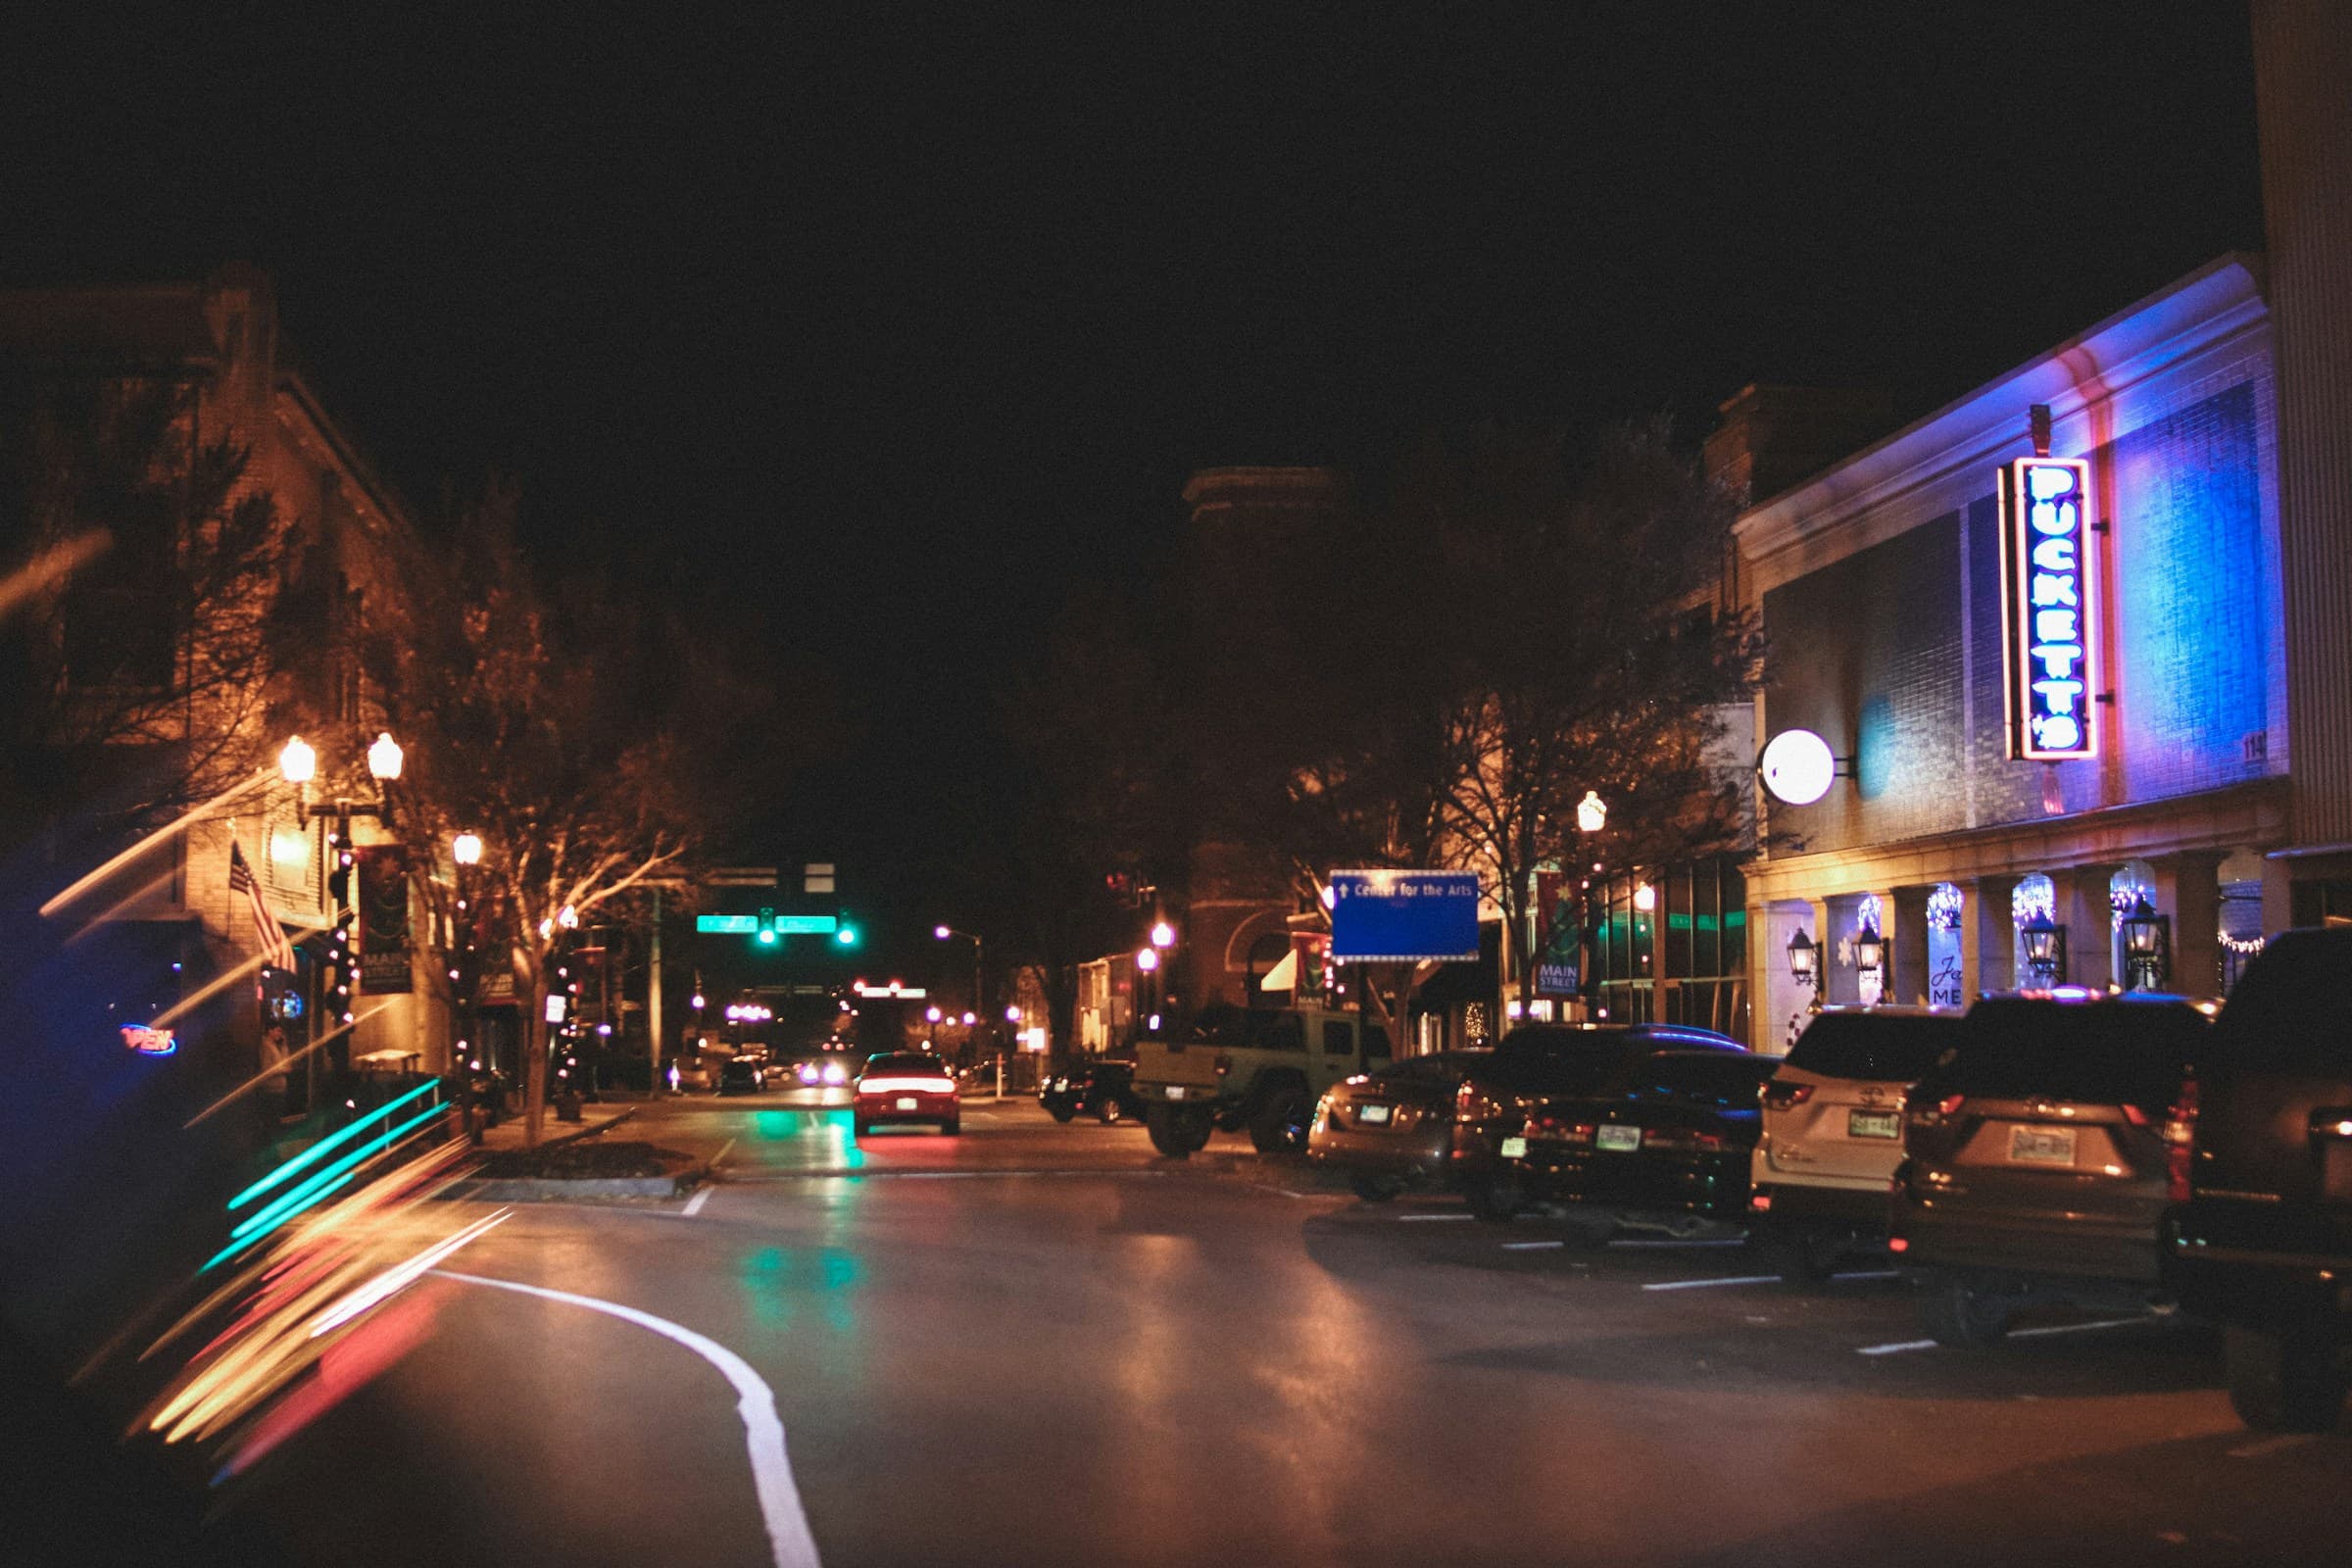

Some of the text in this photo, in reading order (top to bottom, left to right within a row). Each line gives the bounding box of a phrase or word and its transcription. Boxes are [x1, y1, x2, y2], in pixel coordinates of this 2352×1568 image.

[1354, 882, 1473, 897] Center for the Arts
[1540, 964, 1577, 977] MAIN
[1540, 978, 1577, 987] STREET
